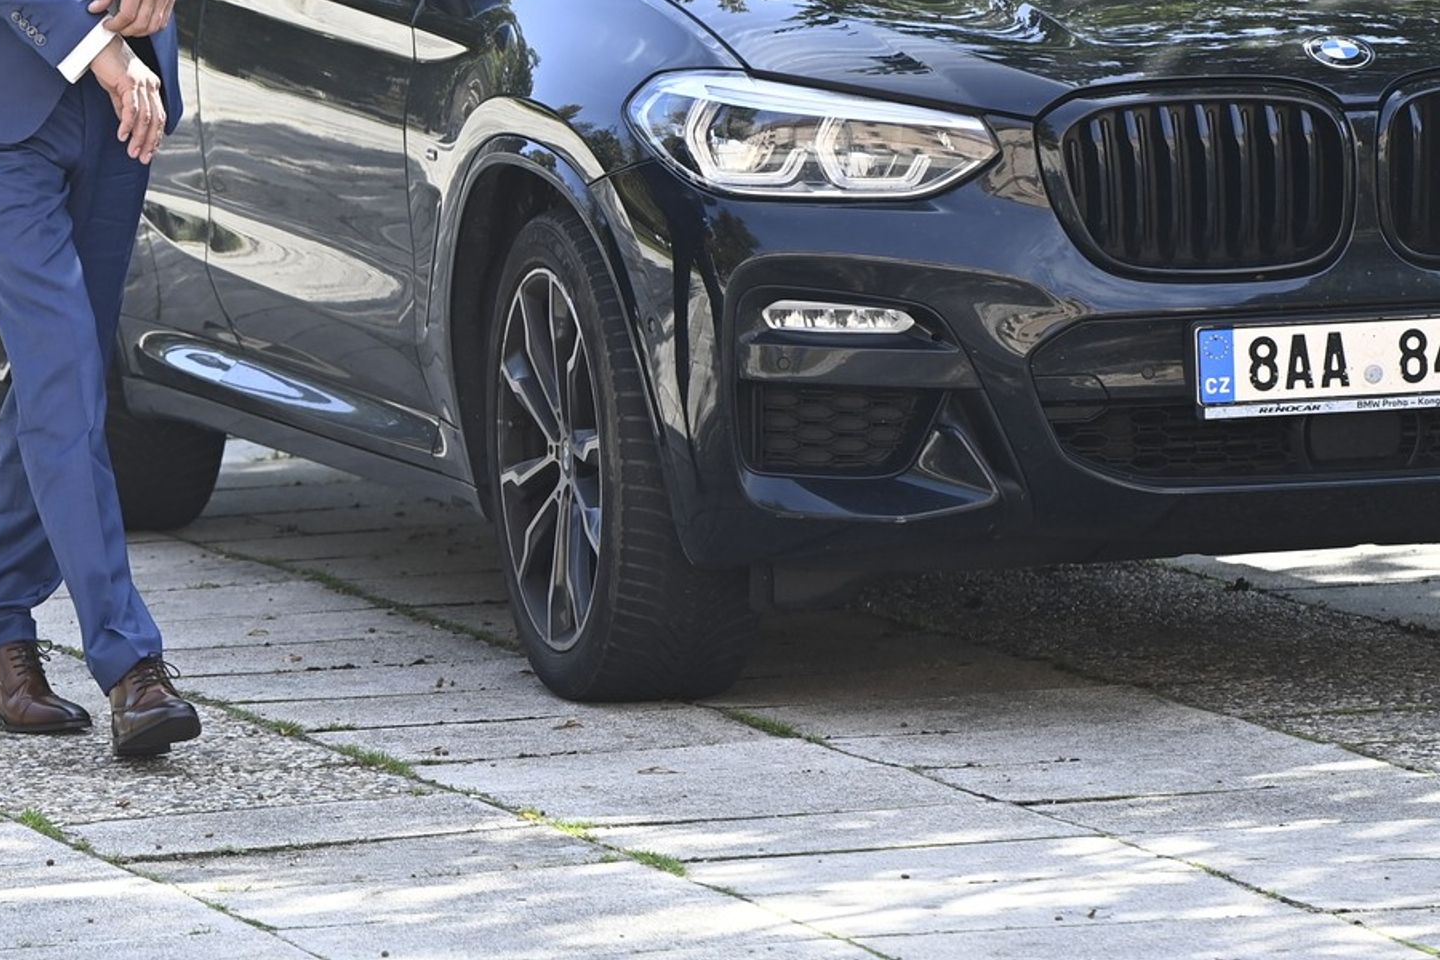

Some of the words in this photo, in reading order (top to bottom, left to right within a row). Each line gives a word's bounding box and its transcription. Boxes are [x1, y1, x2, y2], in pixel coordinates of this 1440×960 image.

[1248, 331, 1350, 391] 8AA
[1205, 376, 1231, 395] CZ
[1356, 400, 1380, 409] BMW
